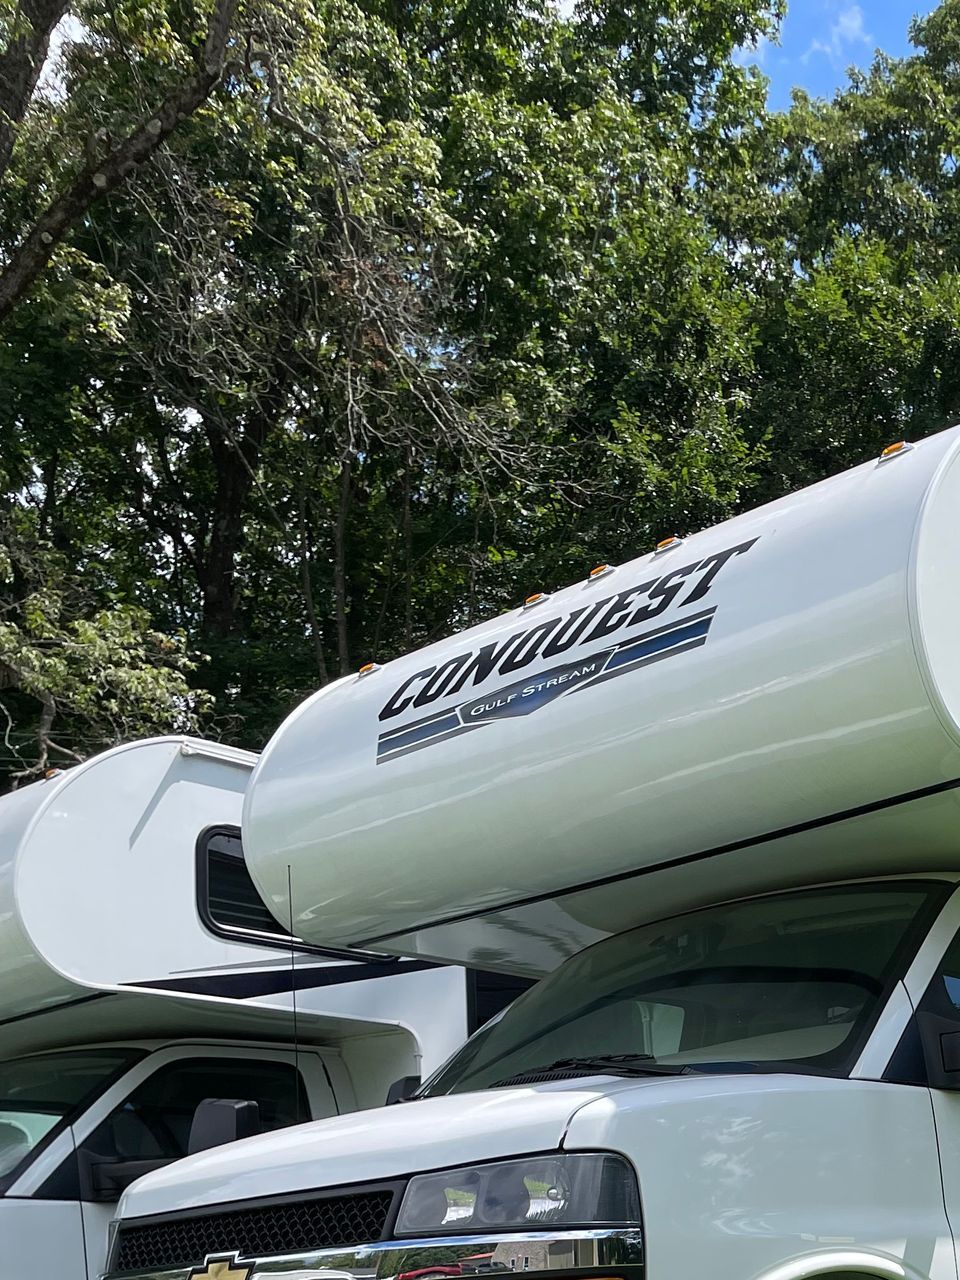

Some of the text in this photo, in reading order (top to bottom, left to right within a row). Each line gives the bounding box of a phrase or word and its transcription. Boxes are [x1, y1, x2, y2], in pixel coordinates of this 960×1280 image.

[378, 536, 761, 721] CONQUEST
[470, 663, 596, 716] GULF STREAM
